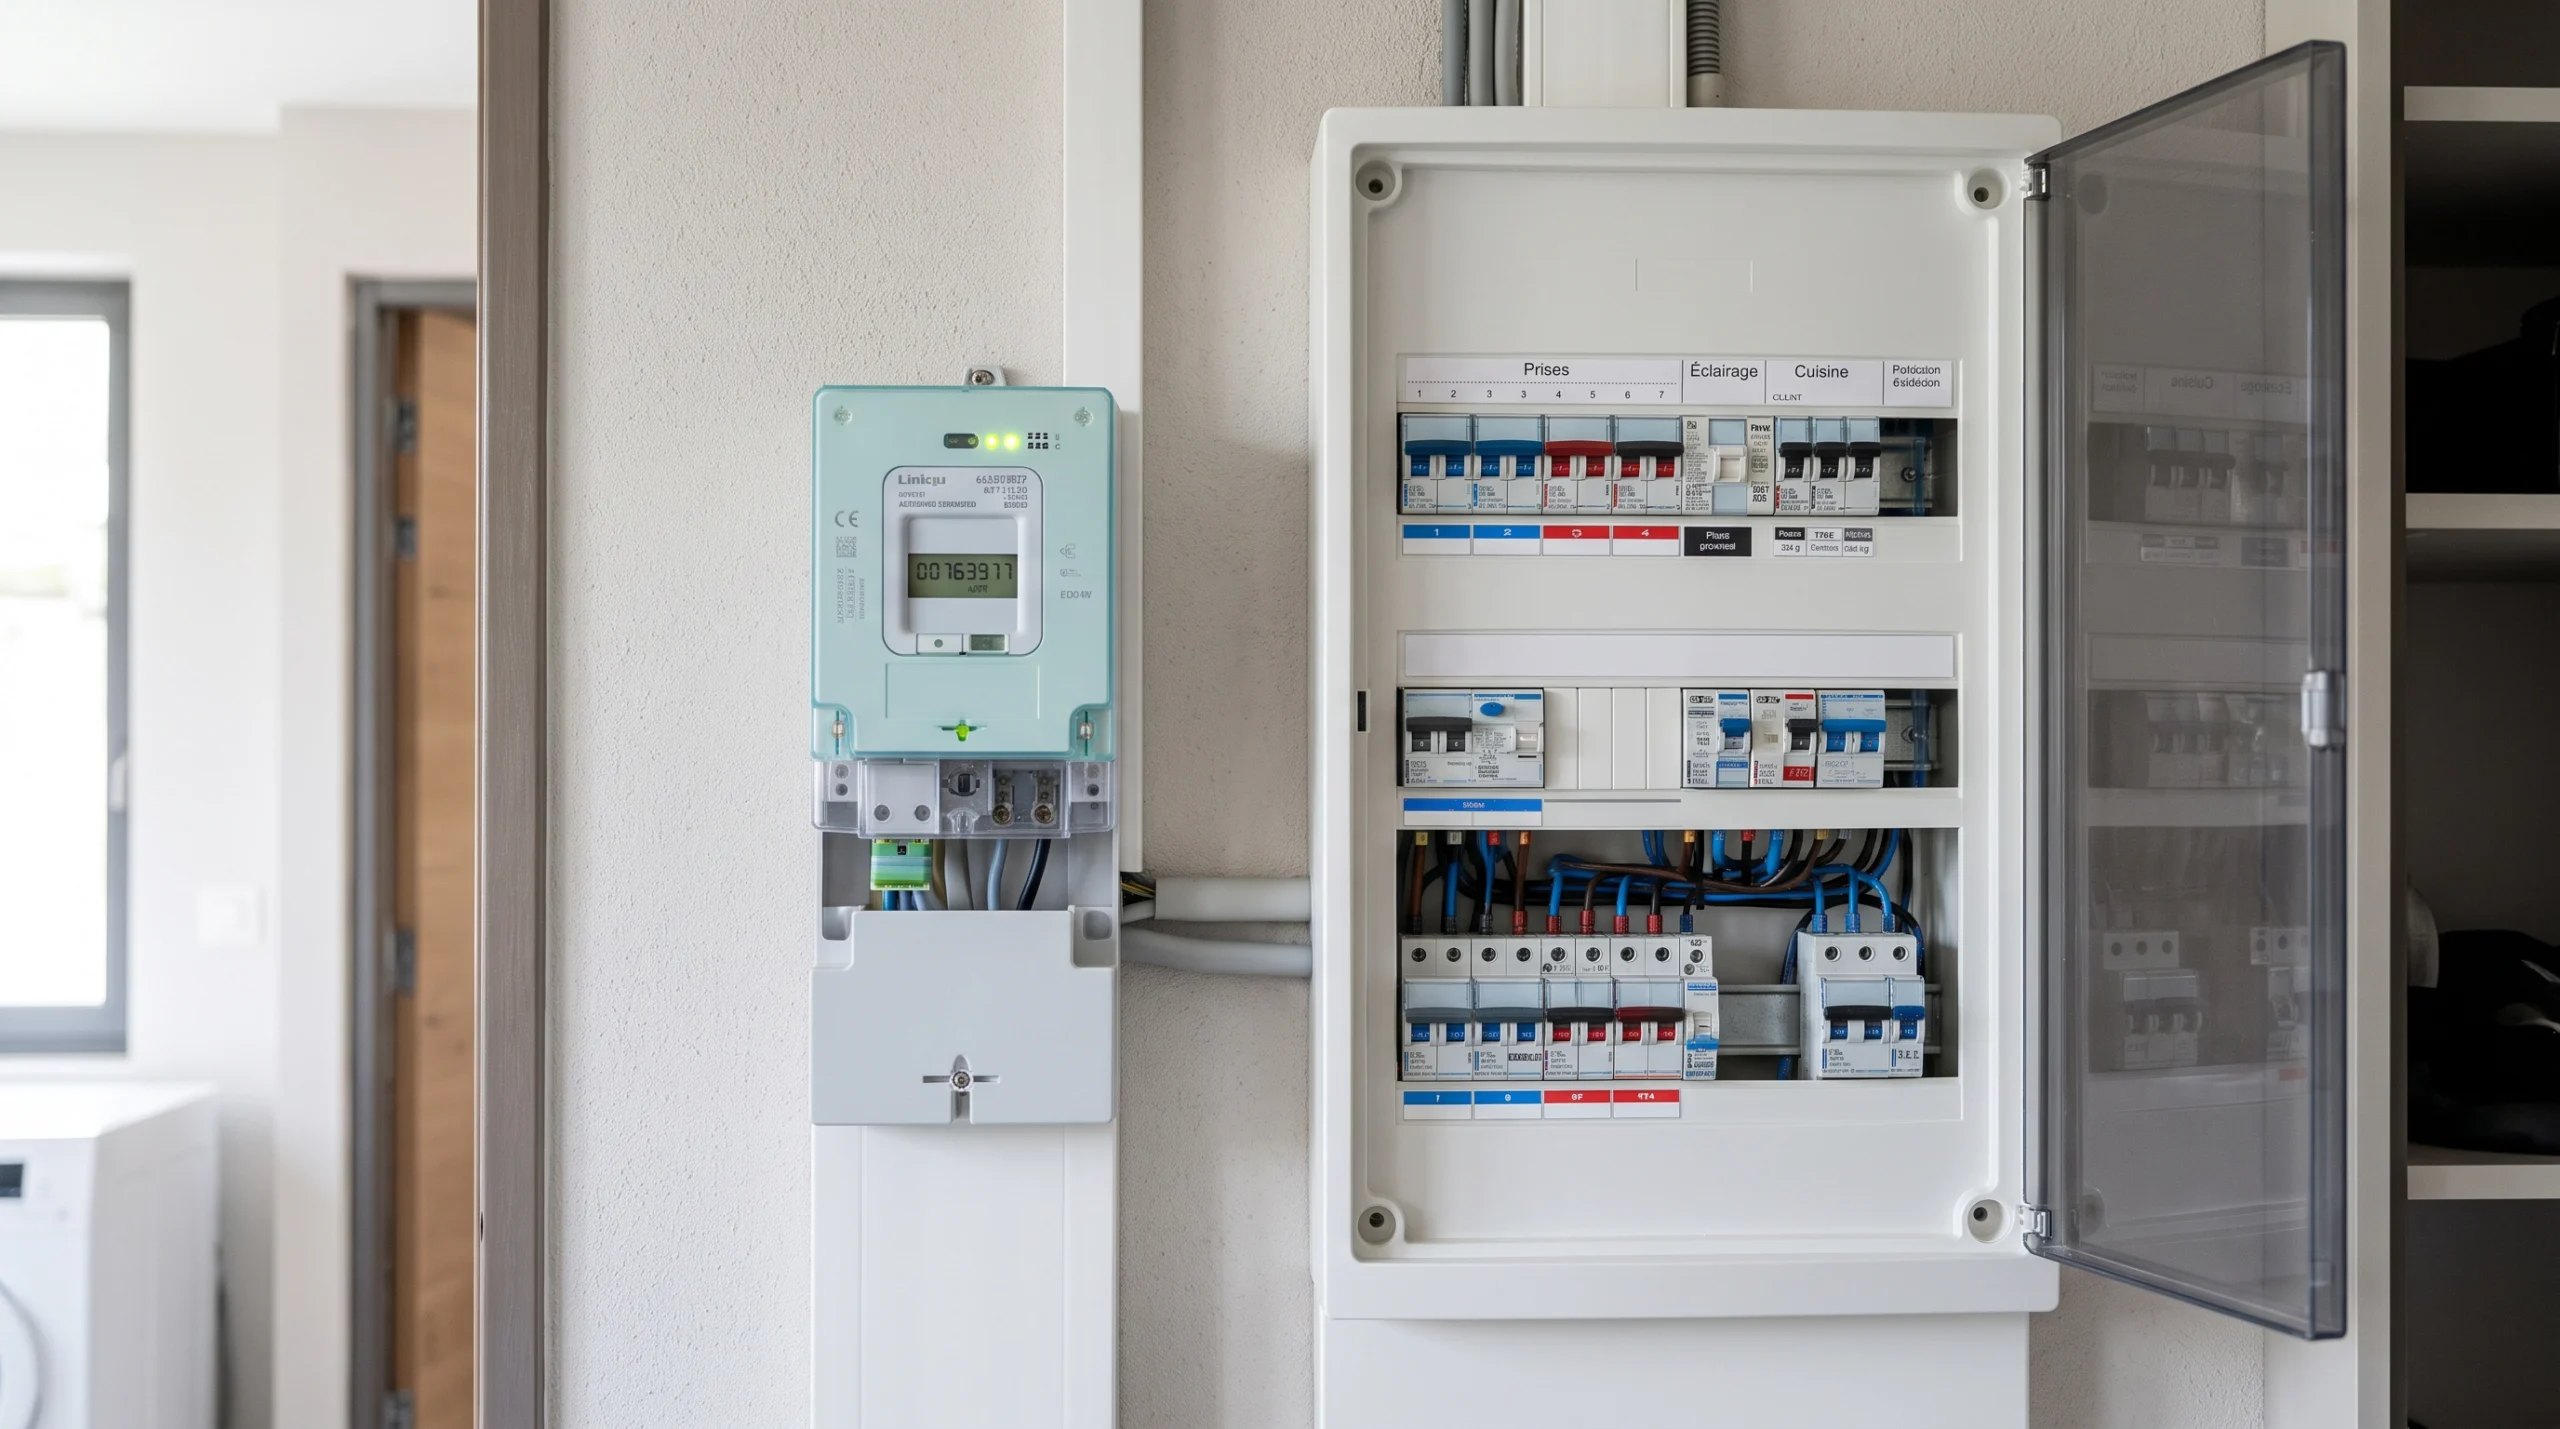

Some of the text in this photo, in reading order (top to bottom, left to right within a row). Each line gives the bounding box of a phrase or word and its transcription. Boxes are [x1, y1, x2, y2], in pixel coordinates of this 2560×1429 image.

[1524, 362, 1570, 376] Prises
[1690, 361, 1758, 381] Éclairage
[1794, 364, 1849, 379] Cuisine
[1417, 390, 1664, 398] 1 2 3 3 4 5 6 7
[1434, 528, 1439, 537] 1
[1503, 528, 1512, 537] 2
[1641, 529, 1650, 537] 4
[916, 562, 1013, 581] 00763977
